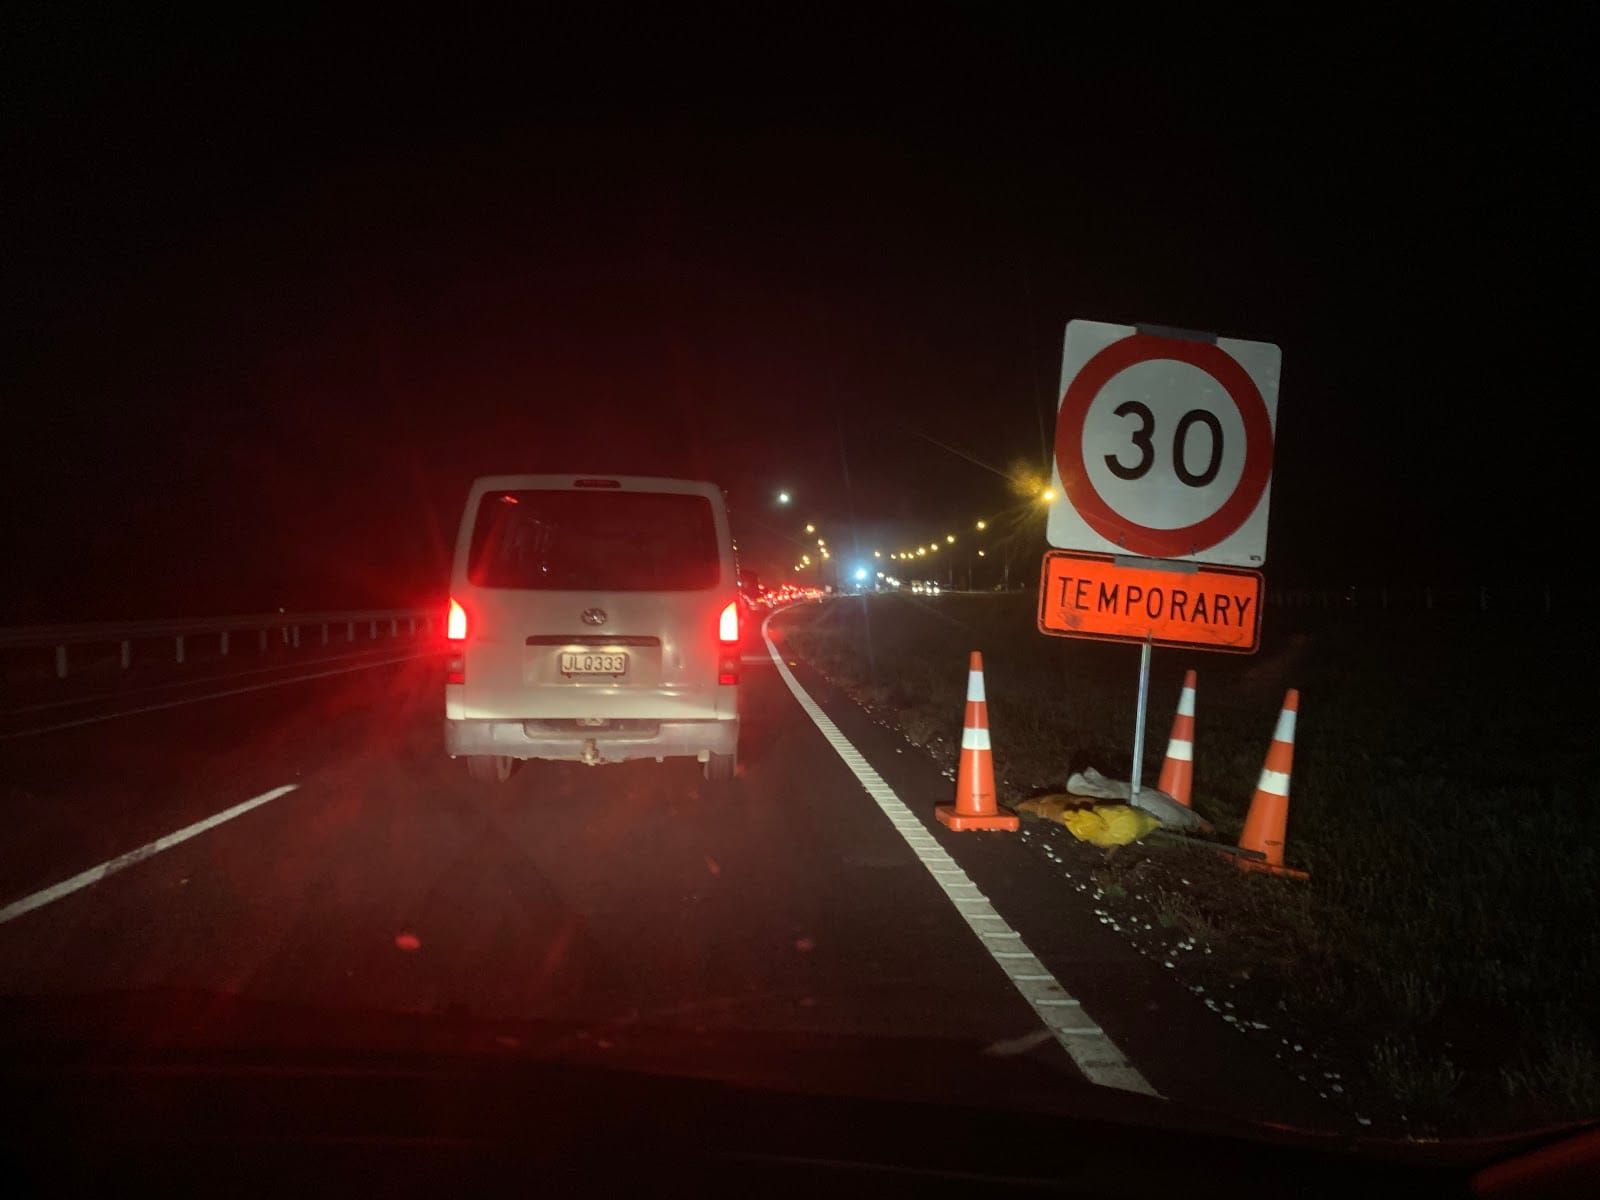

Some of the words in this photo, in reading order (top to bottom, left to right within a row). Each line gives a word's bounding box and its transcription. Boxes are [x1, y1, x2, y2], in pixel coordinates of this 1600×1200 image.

[1104, 401, 1224, 487] 30
[1059, 577, 1251, 627] TEMPORARY
[564, 656, 623, 671] JLQ333
